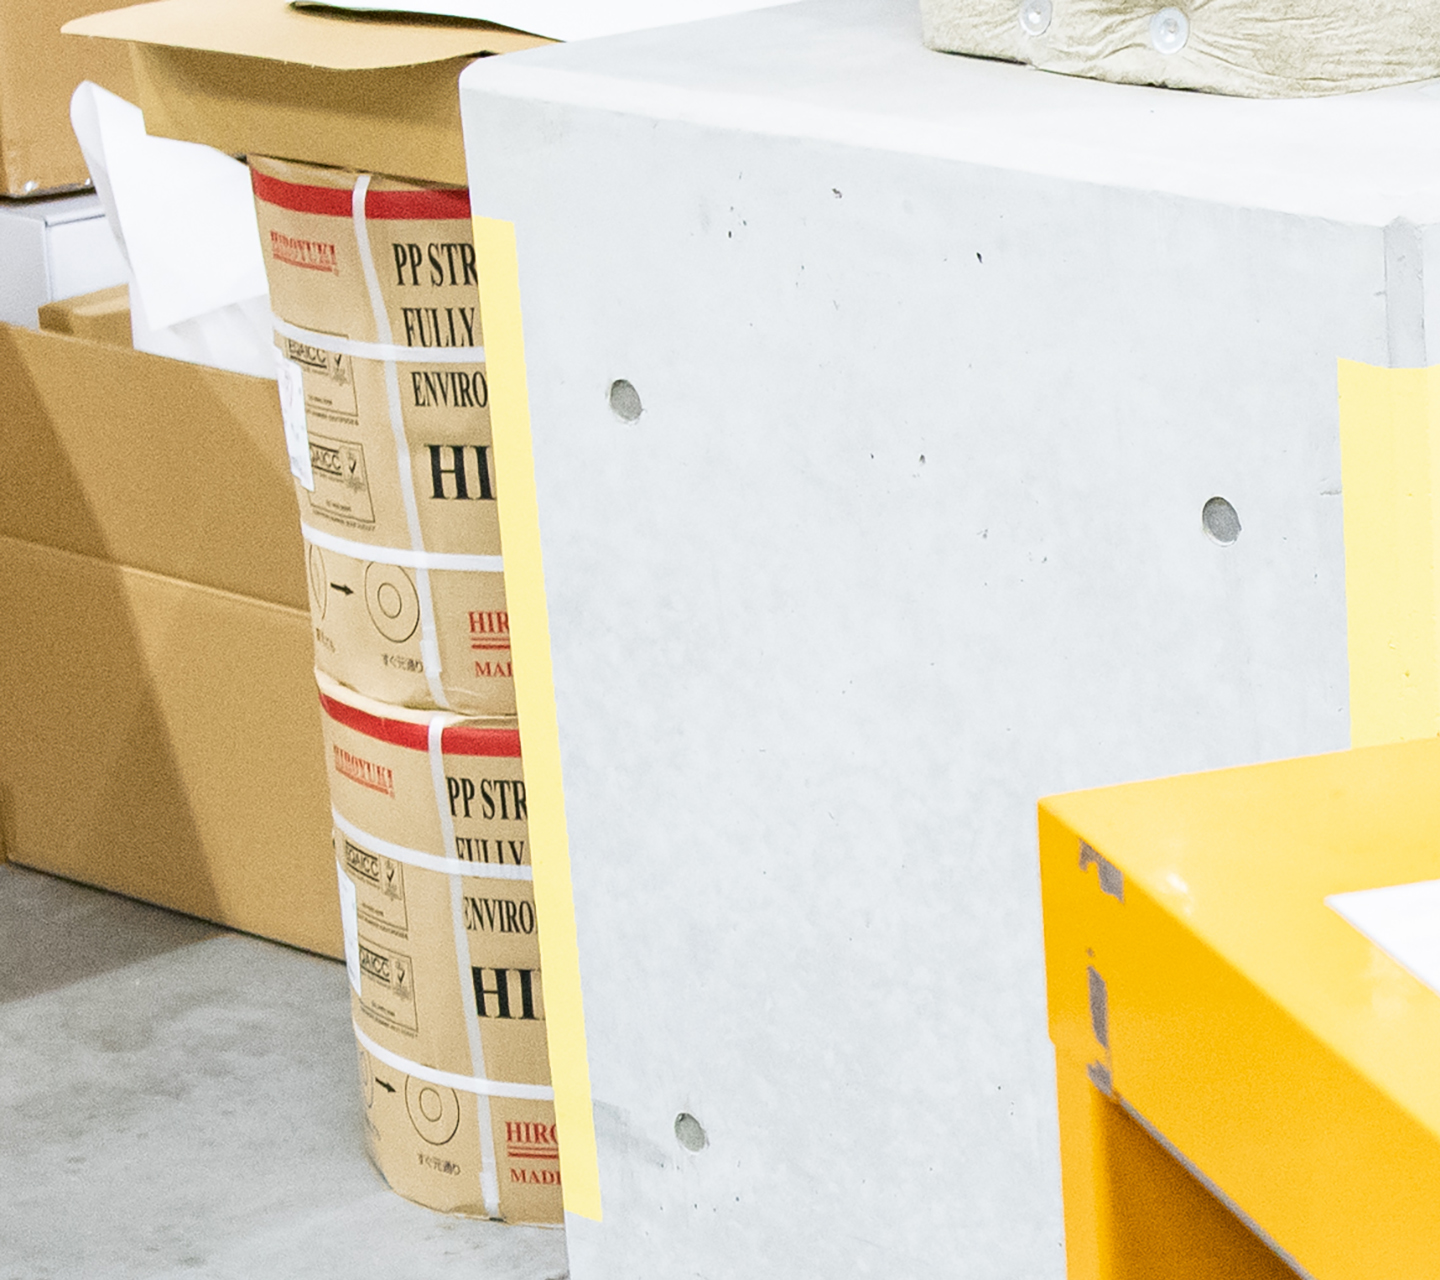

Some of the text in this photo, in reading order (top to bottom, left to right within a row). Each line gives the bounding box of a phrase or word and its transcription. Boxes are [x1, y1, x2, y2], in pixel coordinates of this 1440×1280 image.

[392, 242, 478, 288] PP STR
[401, 306, 475, 348] FULLY
[410, 371, 489, 408] ENVIRO
[423, 443, 498, 501] HI
[468, 611, 510, 634] HIR
[445, 776, 528, 821] PP STR
[463, 896, 539, 935] ENVIRO
[471, 965, 547, 1021] HI
